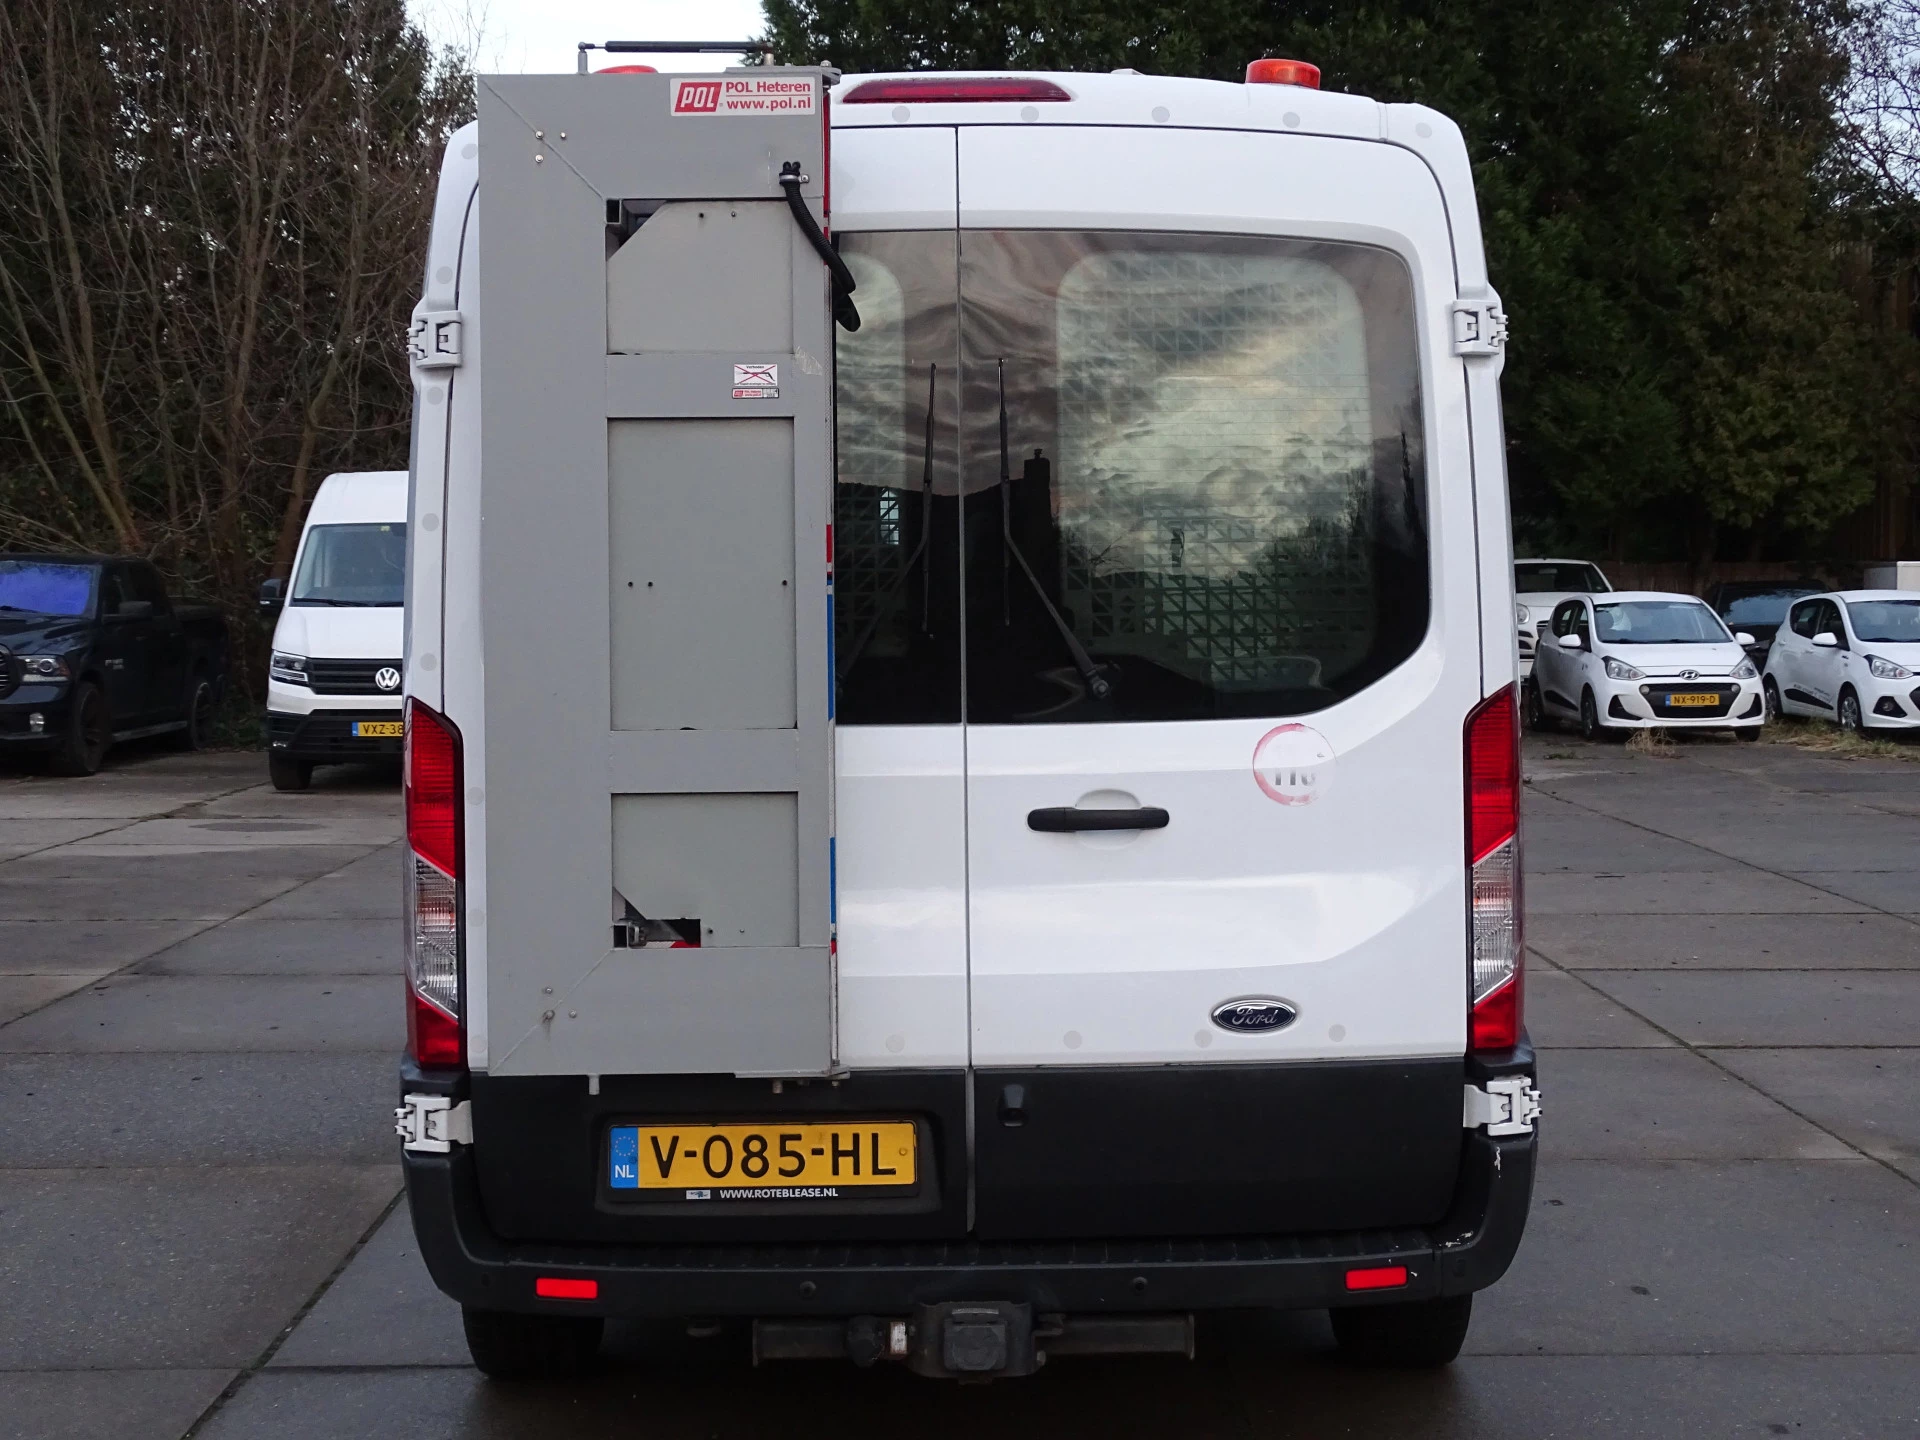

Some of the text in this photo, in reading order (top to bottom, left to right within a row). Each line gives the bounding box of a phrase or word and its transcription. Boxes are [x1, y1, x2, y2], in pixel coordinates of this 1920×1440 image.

[726, 81, 811, 93] POL Heteren
[680, 86, 716, 108] POL
[727, 97, 811, 112] www.pol.nl
[1673, 695, 1716, 705] NX-919-D
[1231, 1005, 1279, 1025] Ford
[650, 1132, 897, 1179] V-085-HL
[614, 1164, 635, 1178] NL
[719, 1187, 839, 1199] WWW.ROTEBLEASE.NL
